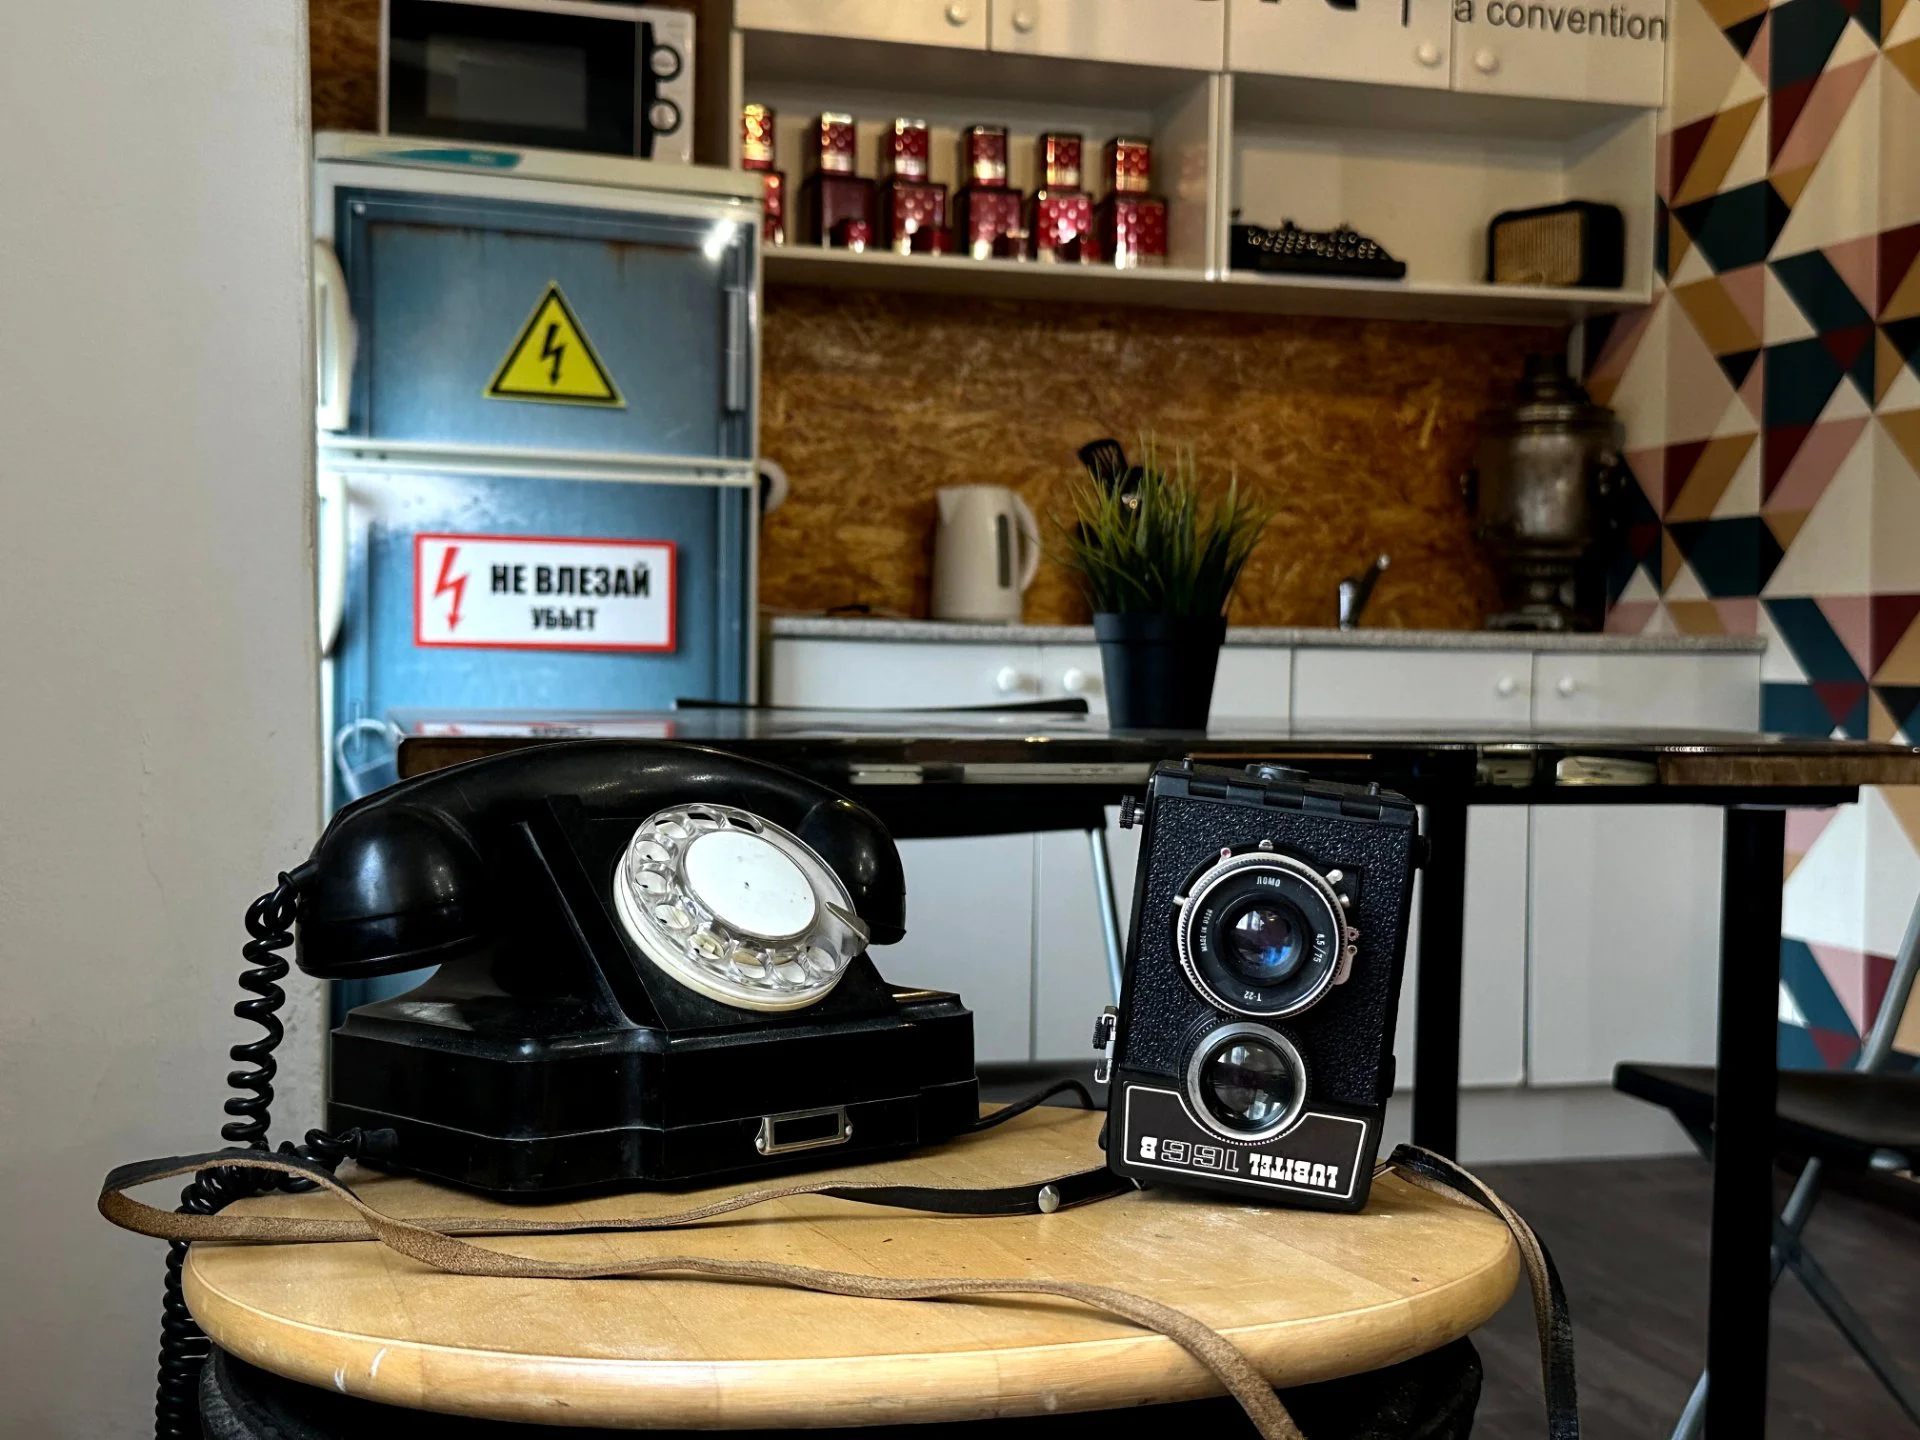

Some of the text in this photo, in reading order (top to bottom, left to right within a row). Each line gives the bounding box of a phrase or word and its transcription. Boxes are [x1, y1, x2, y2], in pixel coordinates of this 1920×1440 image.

[1487, 0, 1666, 42] convention
[490, 561, 650, 598] НЕ ВЛЕЗАЙ
[531, 606, 598, 631] УБЬЕТ
[1160, 1139, 1240, 1173] 166
[1249, 1152, 1339, 1189] LUBITEL
